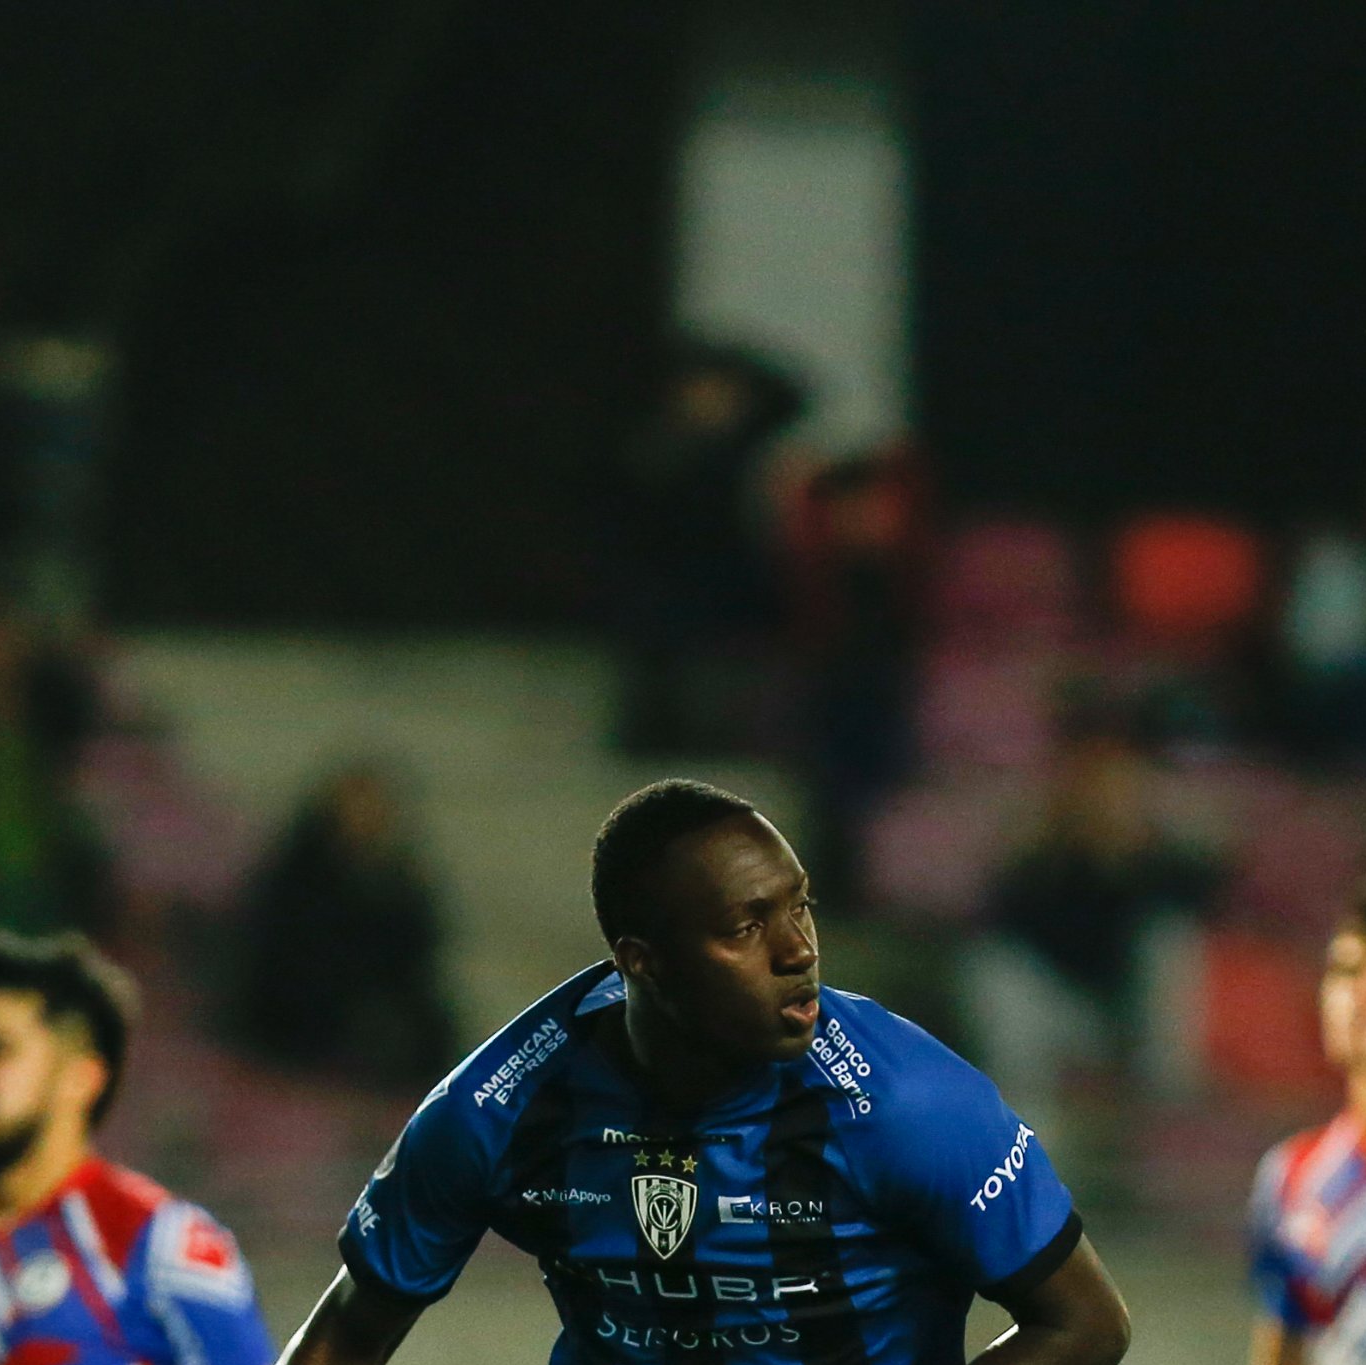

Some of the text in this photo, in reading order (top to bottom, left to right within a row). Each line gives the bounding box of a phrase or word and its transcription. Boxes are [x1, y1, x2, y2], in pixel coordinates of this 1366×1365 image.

[474, 1018, 558, 1107] AMERICAN
[494, 1029, 568, 1105] EXPRESS
[812, 1038, 872, 1114] del Barrio
[826, 1018, 871, 1077] Banco
[970, 1123, 1035, 1211] TOYOTA
